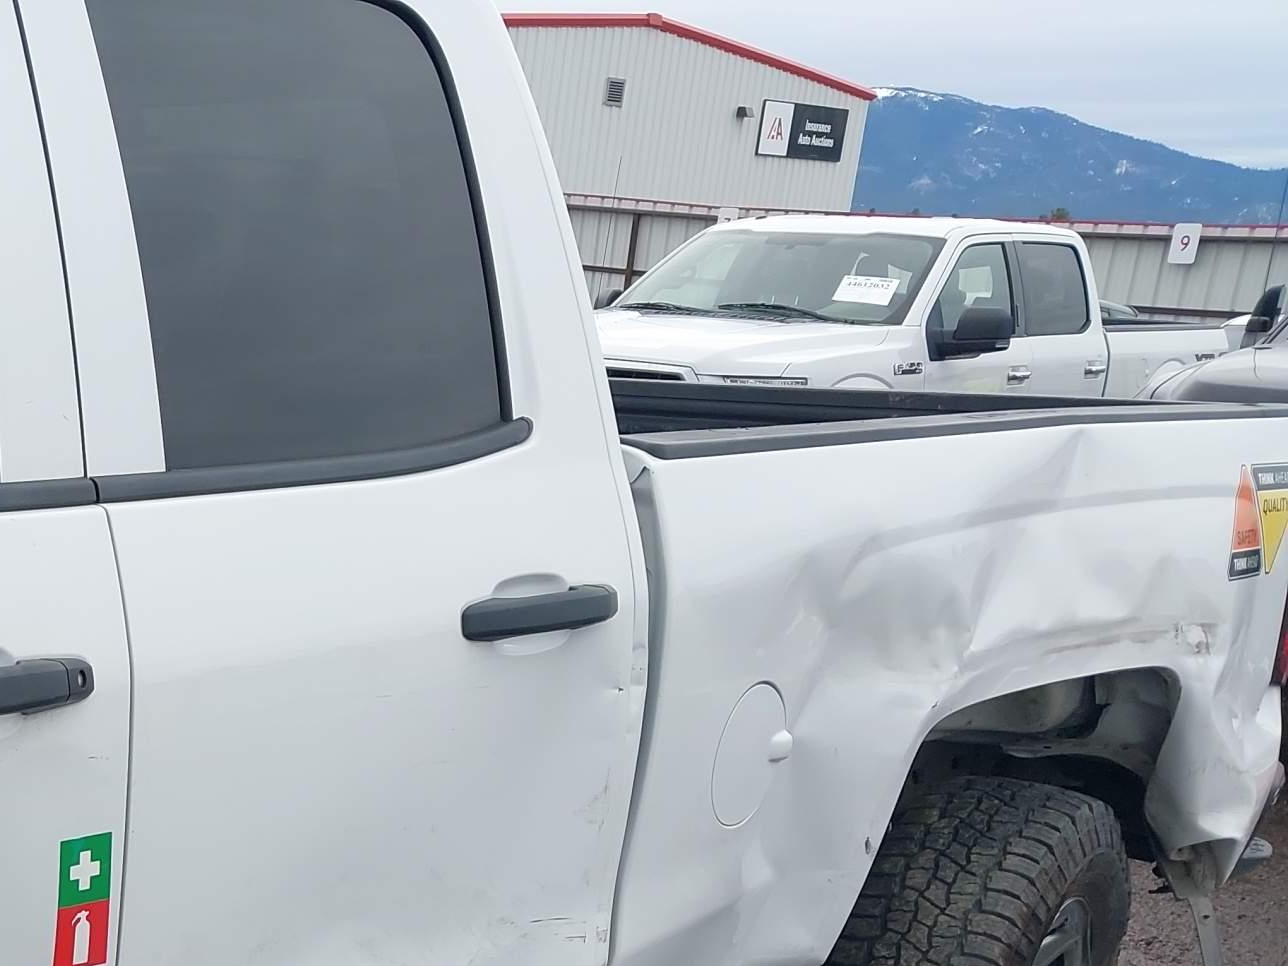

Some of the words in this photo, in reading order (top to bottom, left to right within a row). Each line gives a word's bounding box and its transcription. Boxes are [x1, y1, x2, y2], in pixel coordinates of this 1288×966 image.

[805, 120, 832, 133] Insurance
[798, 133, 811, 145] Auto
[811, 134, 834, 147] Auctions
[1180, 235, 1191, 252] 9
